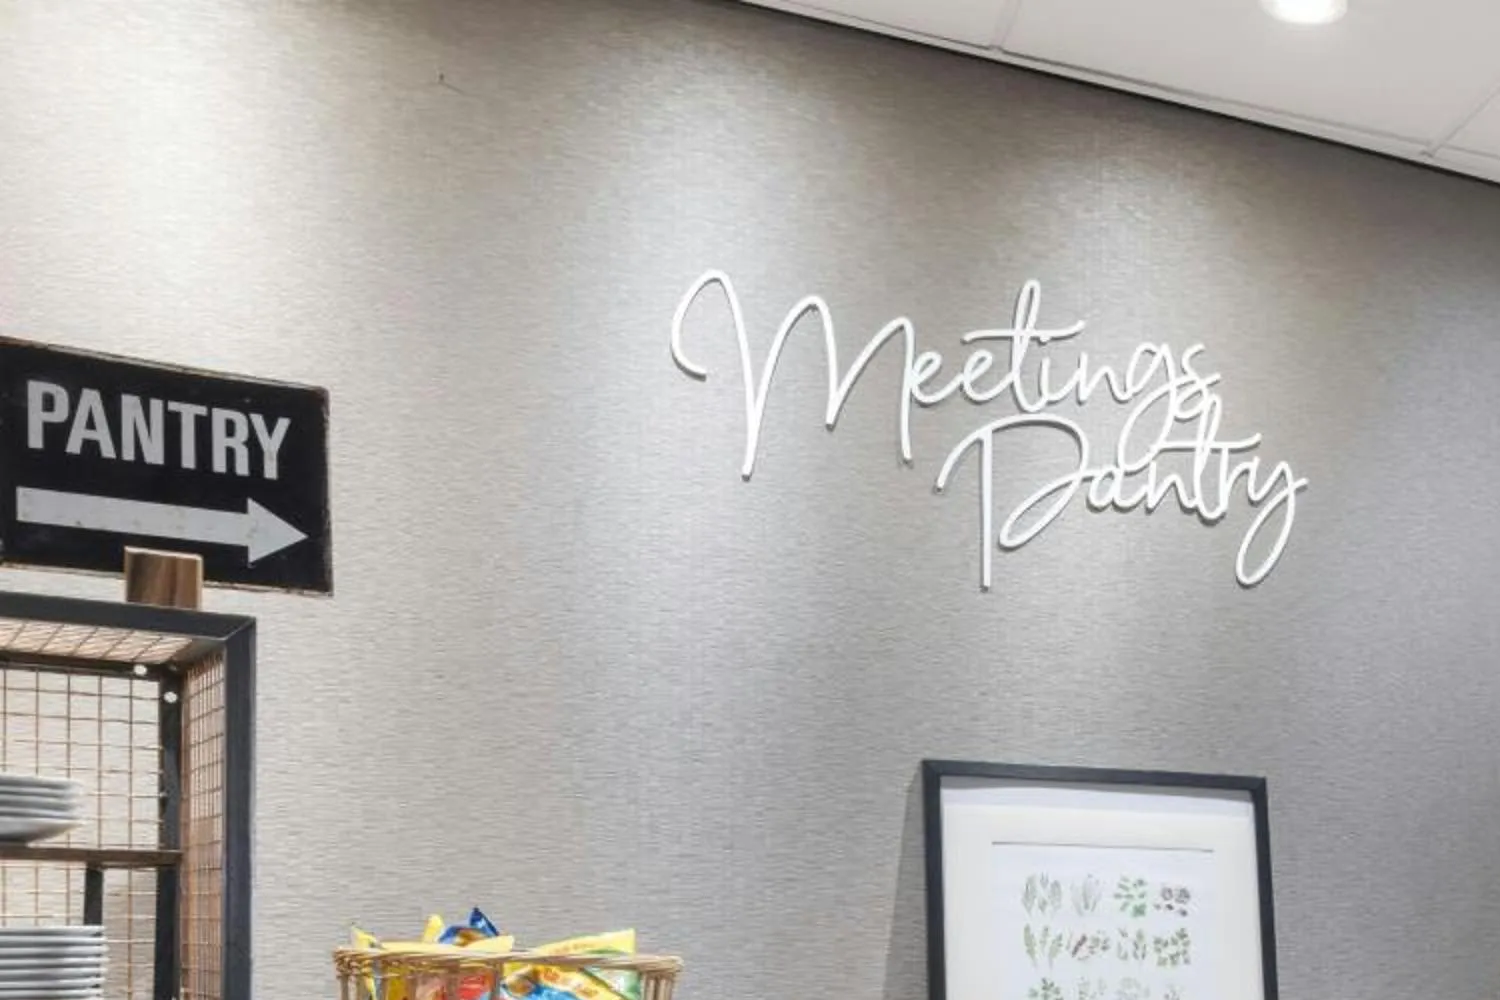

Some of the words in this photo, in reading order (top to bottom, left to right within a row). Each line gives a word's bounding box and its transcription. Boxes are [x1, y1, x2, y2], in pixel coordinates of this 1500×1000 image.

[26, 379, 291, 481] PANTRY
[671, 269, 1221, 479] Meetings
[936, 393, 1308, 591] Pantry
